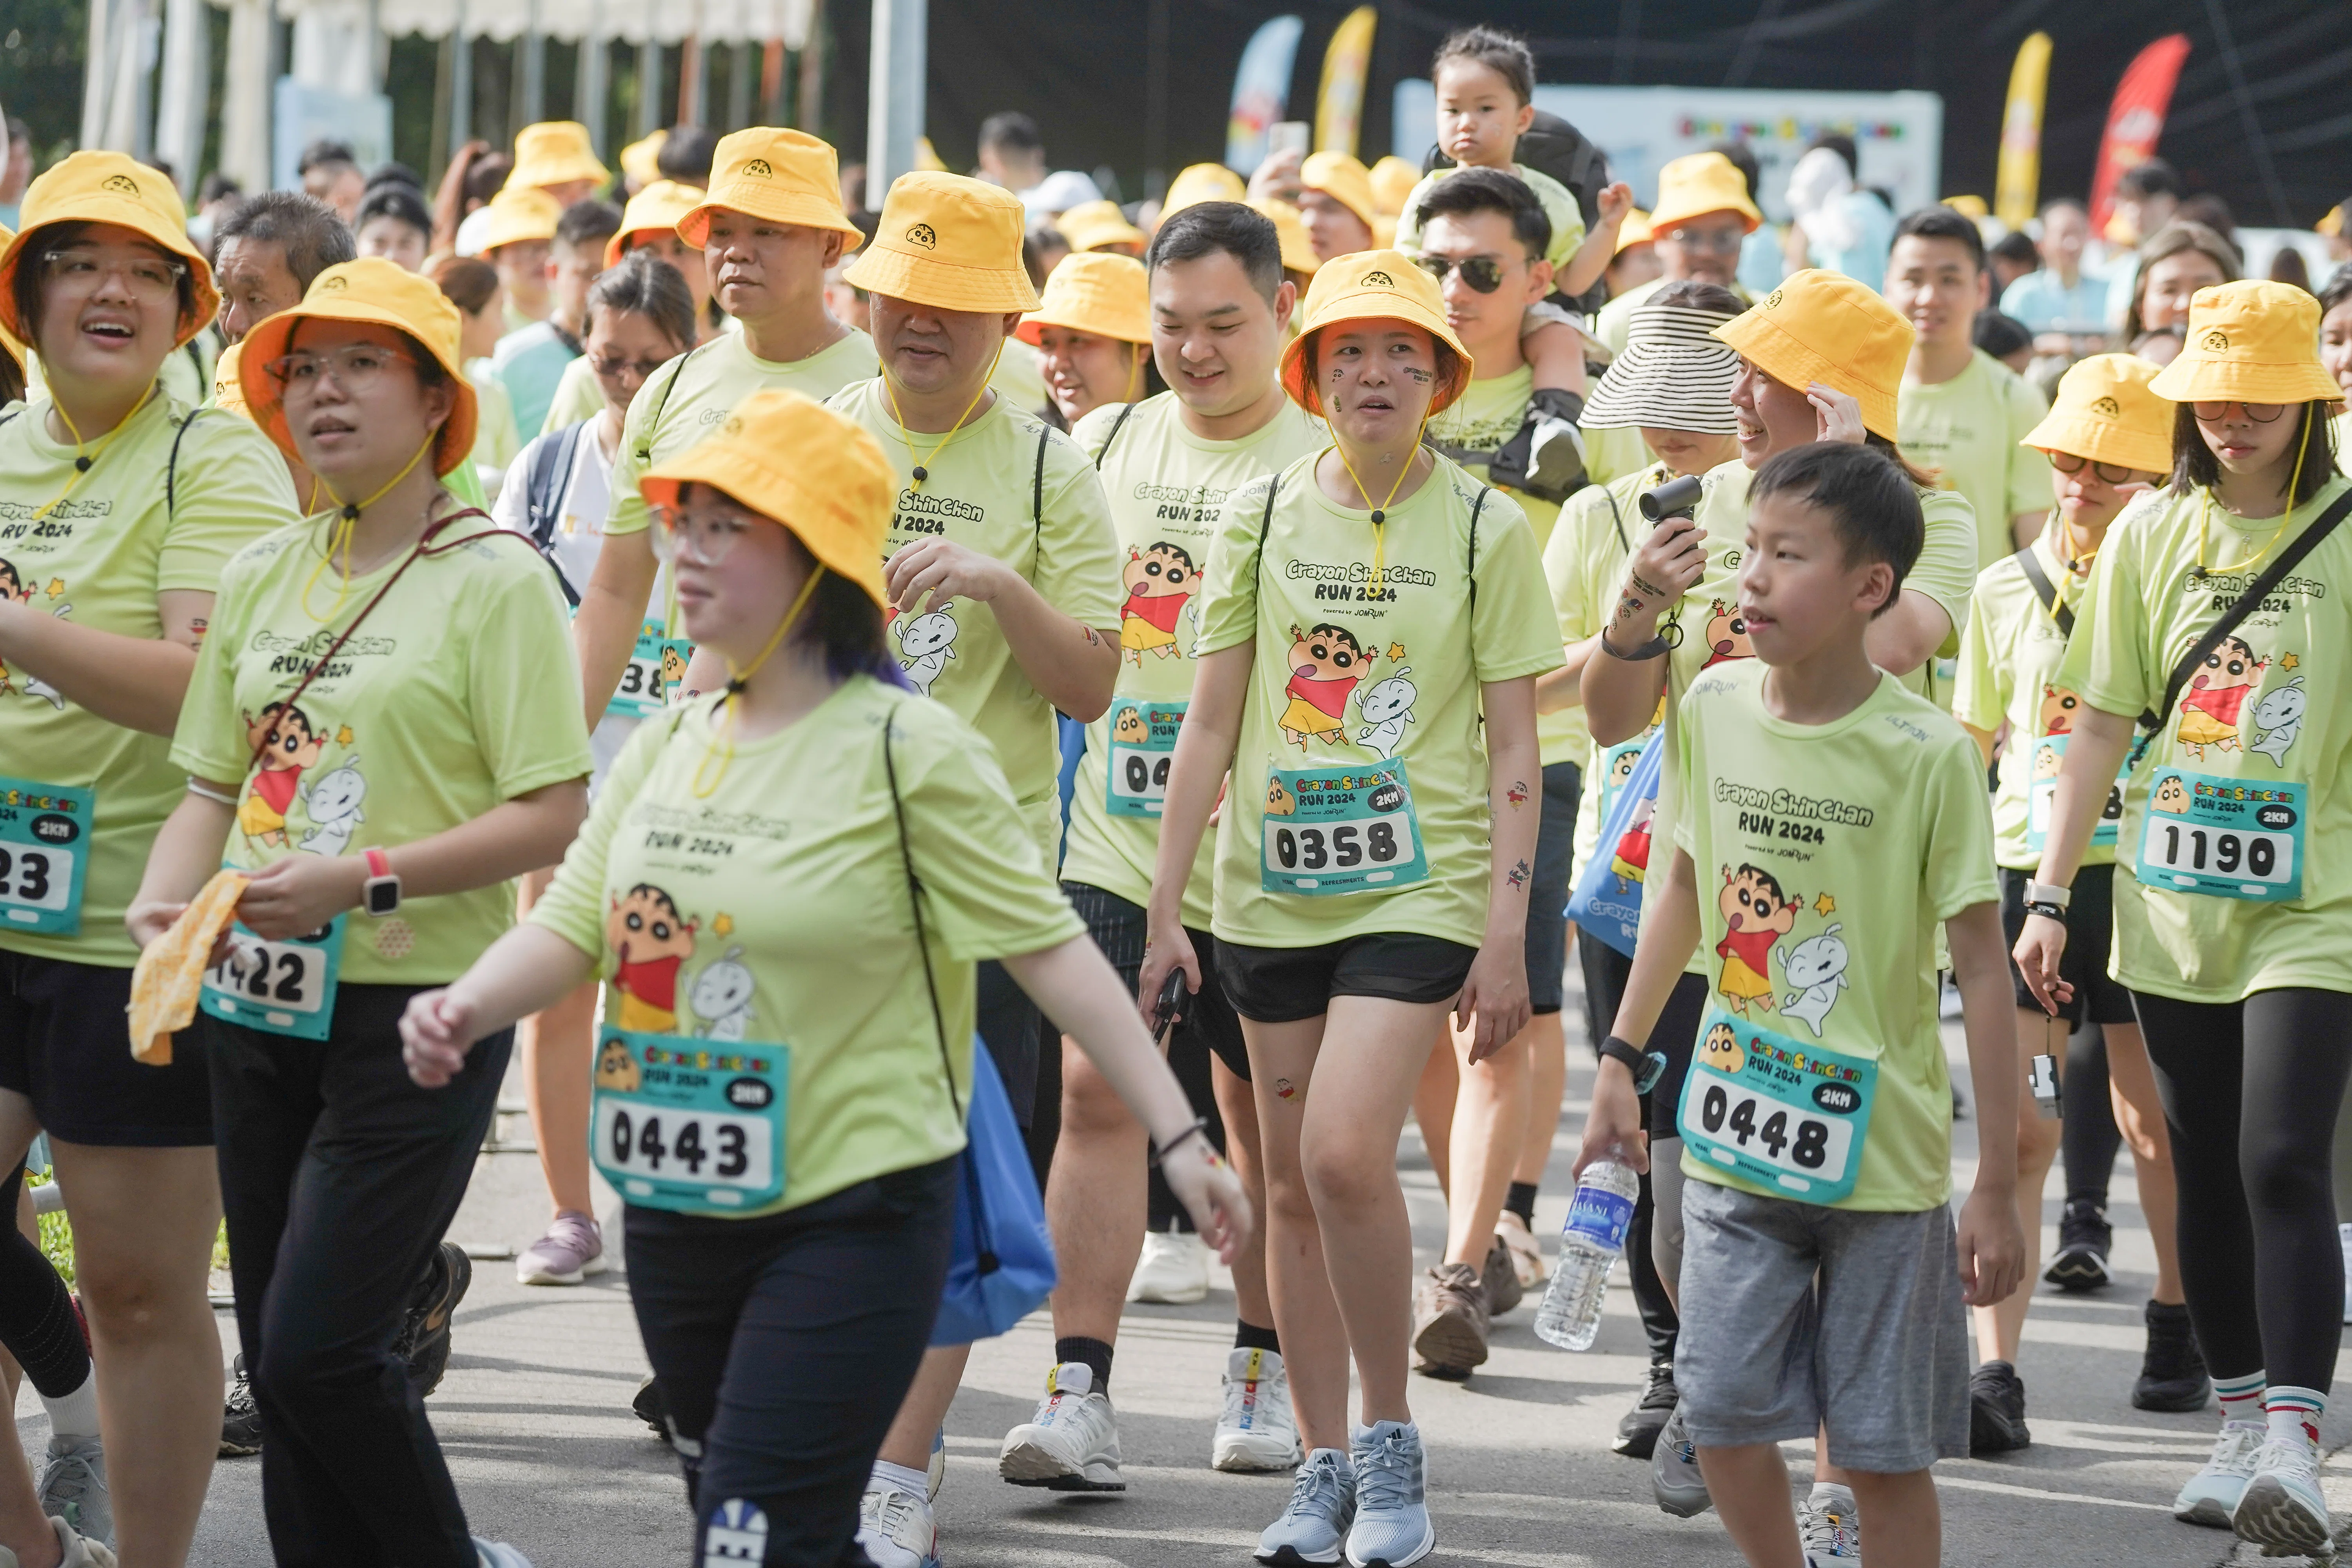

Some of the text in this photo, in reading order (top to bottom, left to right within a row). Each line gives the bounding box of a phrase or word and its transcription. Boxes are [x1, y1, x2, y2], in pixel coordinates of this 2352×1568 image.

[699, 408, 731, 425] Cra
[1134, 482, 1189, 503] Crayon
[898, 488, 984, 523] ShinChan
[1156, 505, 1221, 522] RUN 202
[904, 516, 945, 535] 2024
[1285, 559, 1436, 586] Crayon ShinChan
[1314, 583, 1397, 603] RUN 2024
[2243, 572, 2326, 599] SnChan
[2212, 595, 2244, 612] RU
[1149, 710, 1186, 724] Crayo
[1152, 725, 1175, 736] RUN
[1296, 769, 1397, 793] Crayon ShinChan
[2194, 781, 2294, 804] Crayon ShinChan
[1299, 793, 1356, 806] RUN 2024
[1376, 791, 1399, 806] 2KM
[1714, 777, 1874, 828] Crayon ShinChan
[1739, 812, 1825, 846] RUN 2024
[1276, 822, 1397, 869] 0358
[2165, 826, 2275, 877] 1190
[1321, 877, 1364, 886] REFRESHMENTS
[1748, 1055, 1773, 1075] RUN
[1774, 1066, 1802, 1086] 2024
[1751, 1036, 1862, 1083] Crayon ShinChan
[1820, 1088, 1851, 1108] 2KM
[1702, 1085, 1828, 1169] 0448
[613, 1110, 748, 1176] 0443
